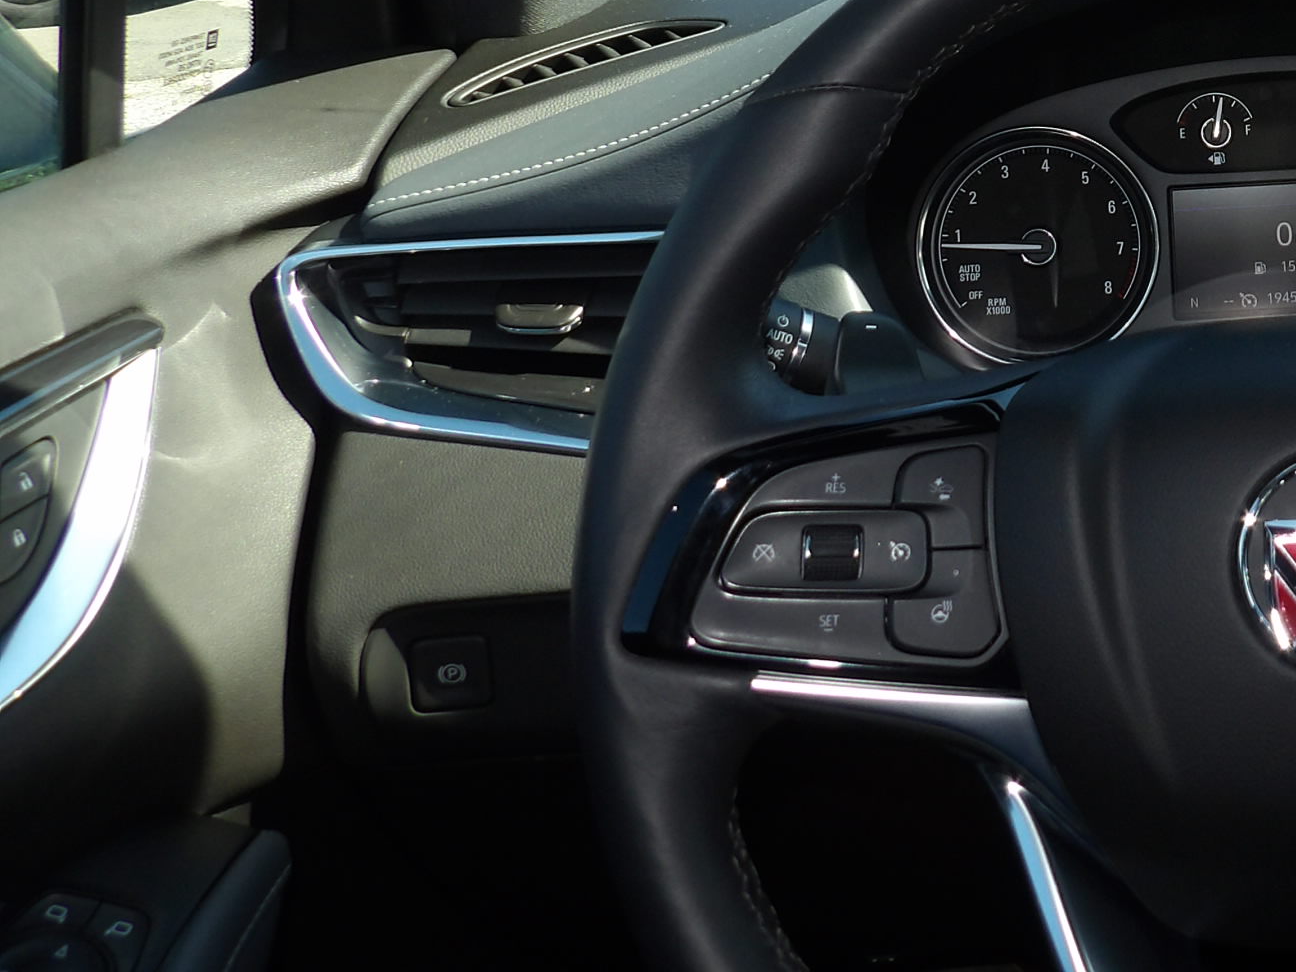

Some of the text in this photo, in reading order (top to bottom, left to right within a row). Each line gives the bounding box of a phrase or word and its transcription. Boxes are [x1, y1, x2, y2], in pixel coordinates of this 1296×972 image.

[1179, 127, 1186, 139] E
[1245, 124, 1251, 135] F
[1000, 165, 1009, 179] 3
[1041, 159, 1050, 173] 4
[1081, 171, 1090, 185] 5
[968, 191, 977, 205] 2
[1107, 200, 1116, 214] 6
[954, 229, 961, 243] 1
[1276, 221, 1293, 246] 0
[1116, 241, 1124, 255] 7
[958, 264, 981, 273] AUTO
[959, 273, 981, 282] STOP
[1104, 280, 1113, 295] 8
[968, 290, 983, 300] OFF
[987, 298, 1007, 307] RPM
[1190, 297, 1200, 309] N
[986, 306, 1011, 316] X1000
[766, 328, 793, 345] AUTO
[825, 481, 846, 494] RES
[819, 613, 840, 627] SET
